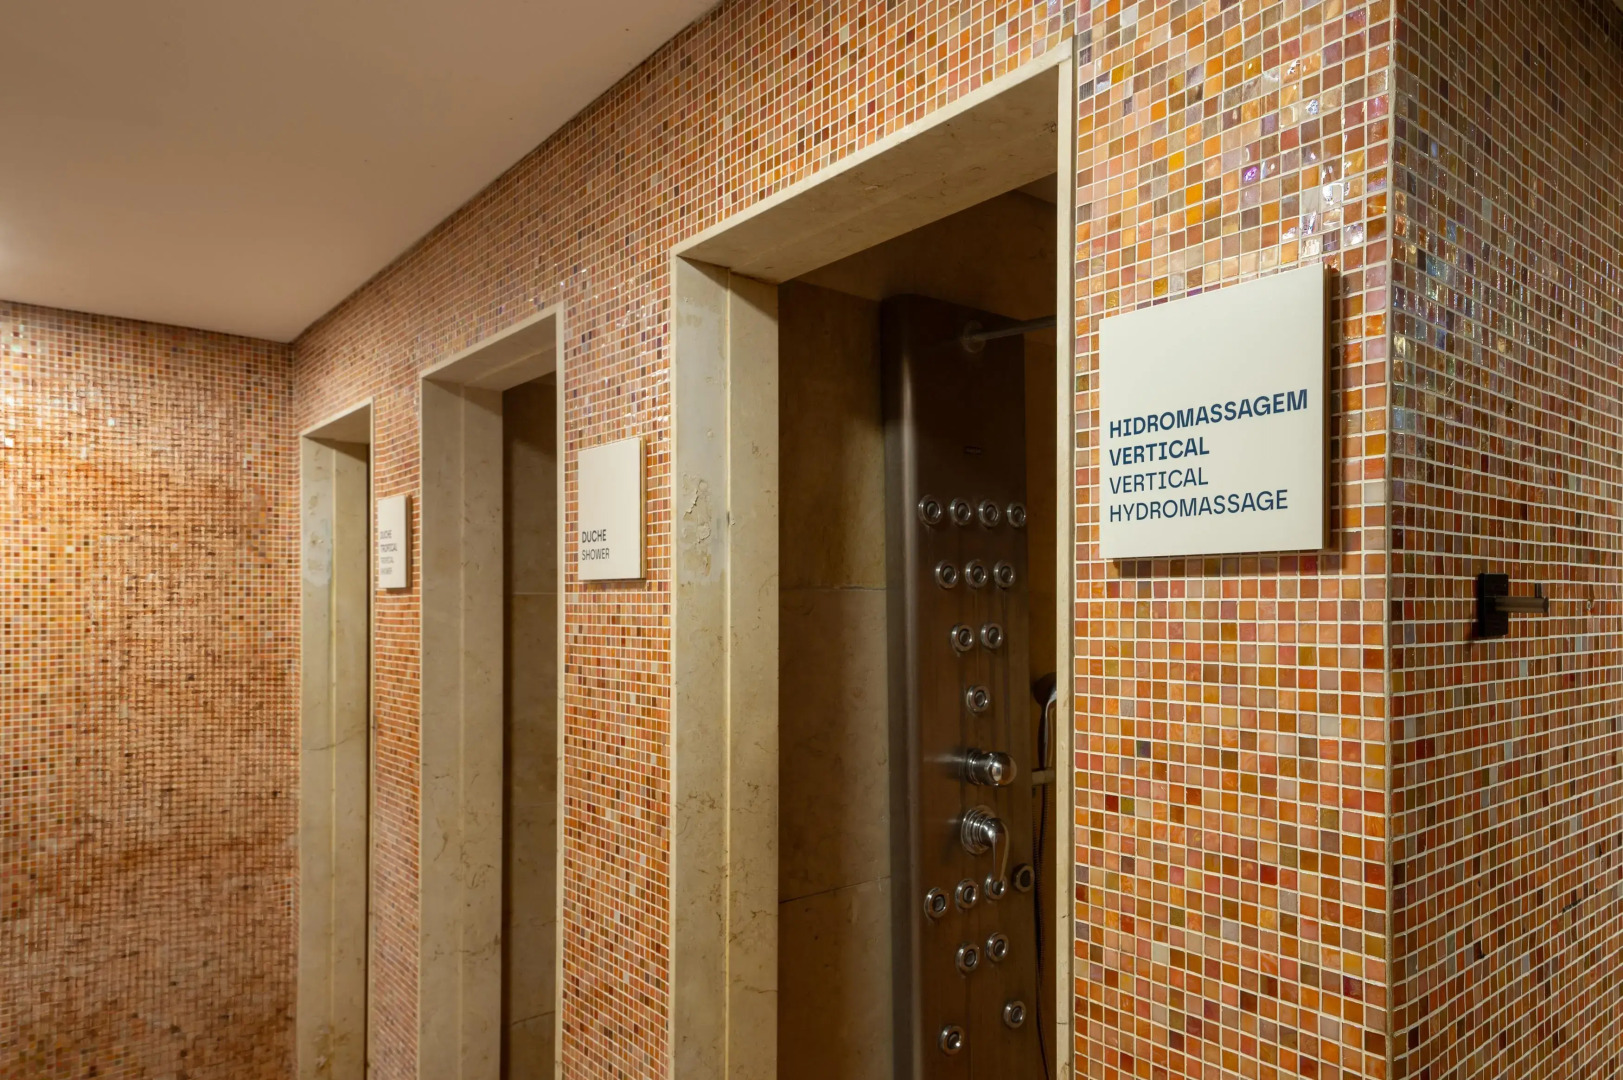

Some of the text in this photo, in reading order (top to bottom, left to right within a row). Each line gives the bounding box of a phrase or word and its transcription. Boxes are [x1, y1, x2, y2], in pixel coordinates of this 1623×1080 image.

[1109, 388, 1308, 438] HIDROMASSAGEM
[1109, 437, 1210, 466] VERTICAL
[1109, 467, 1209, 494] VERTICAL
[1109, 489, 1289, 522] HYDROMASSAGE
[582, 529, 607, 543] DUCHE
[582, 547, 610, 561] SHOWER
